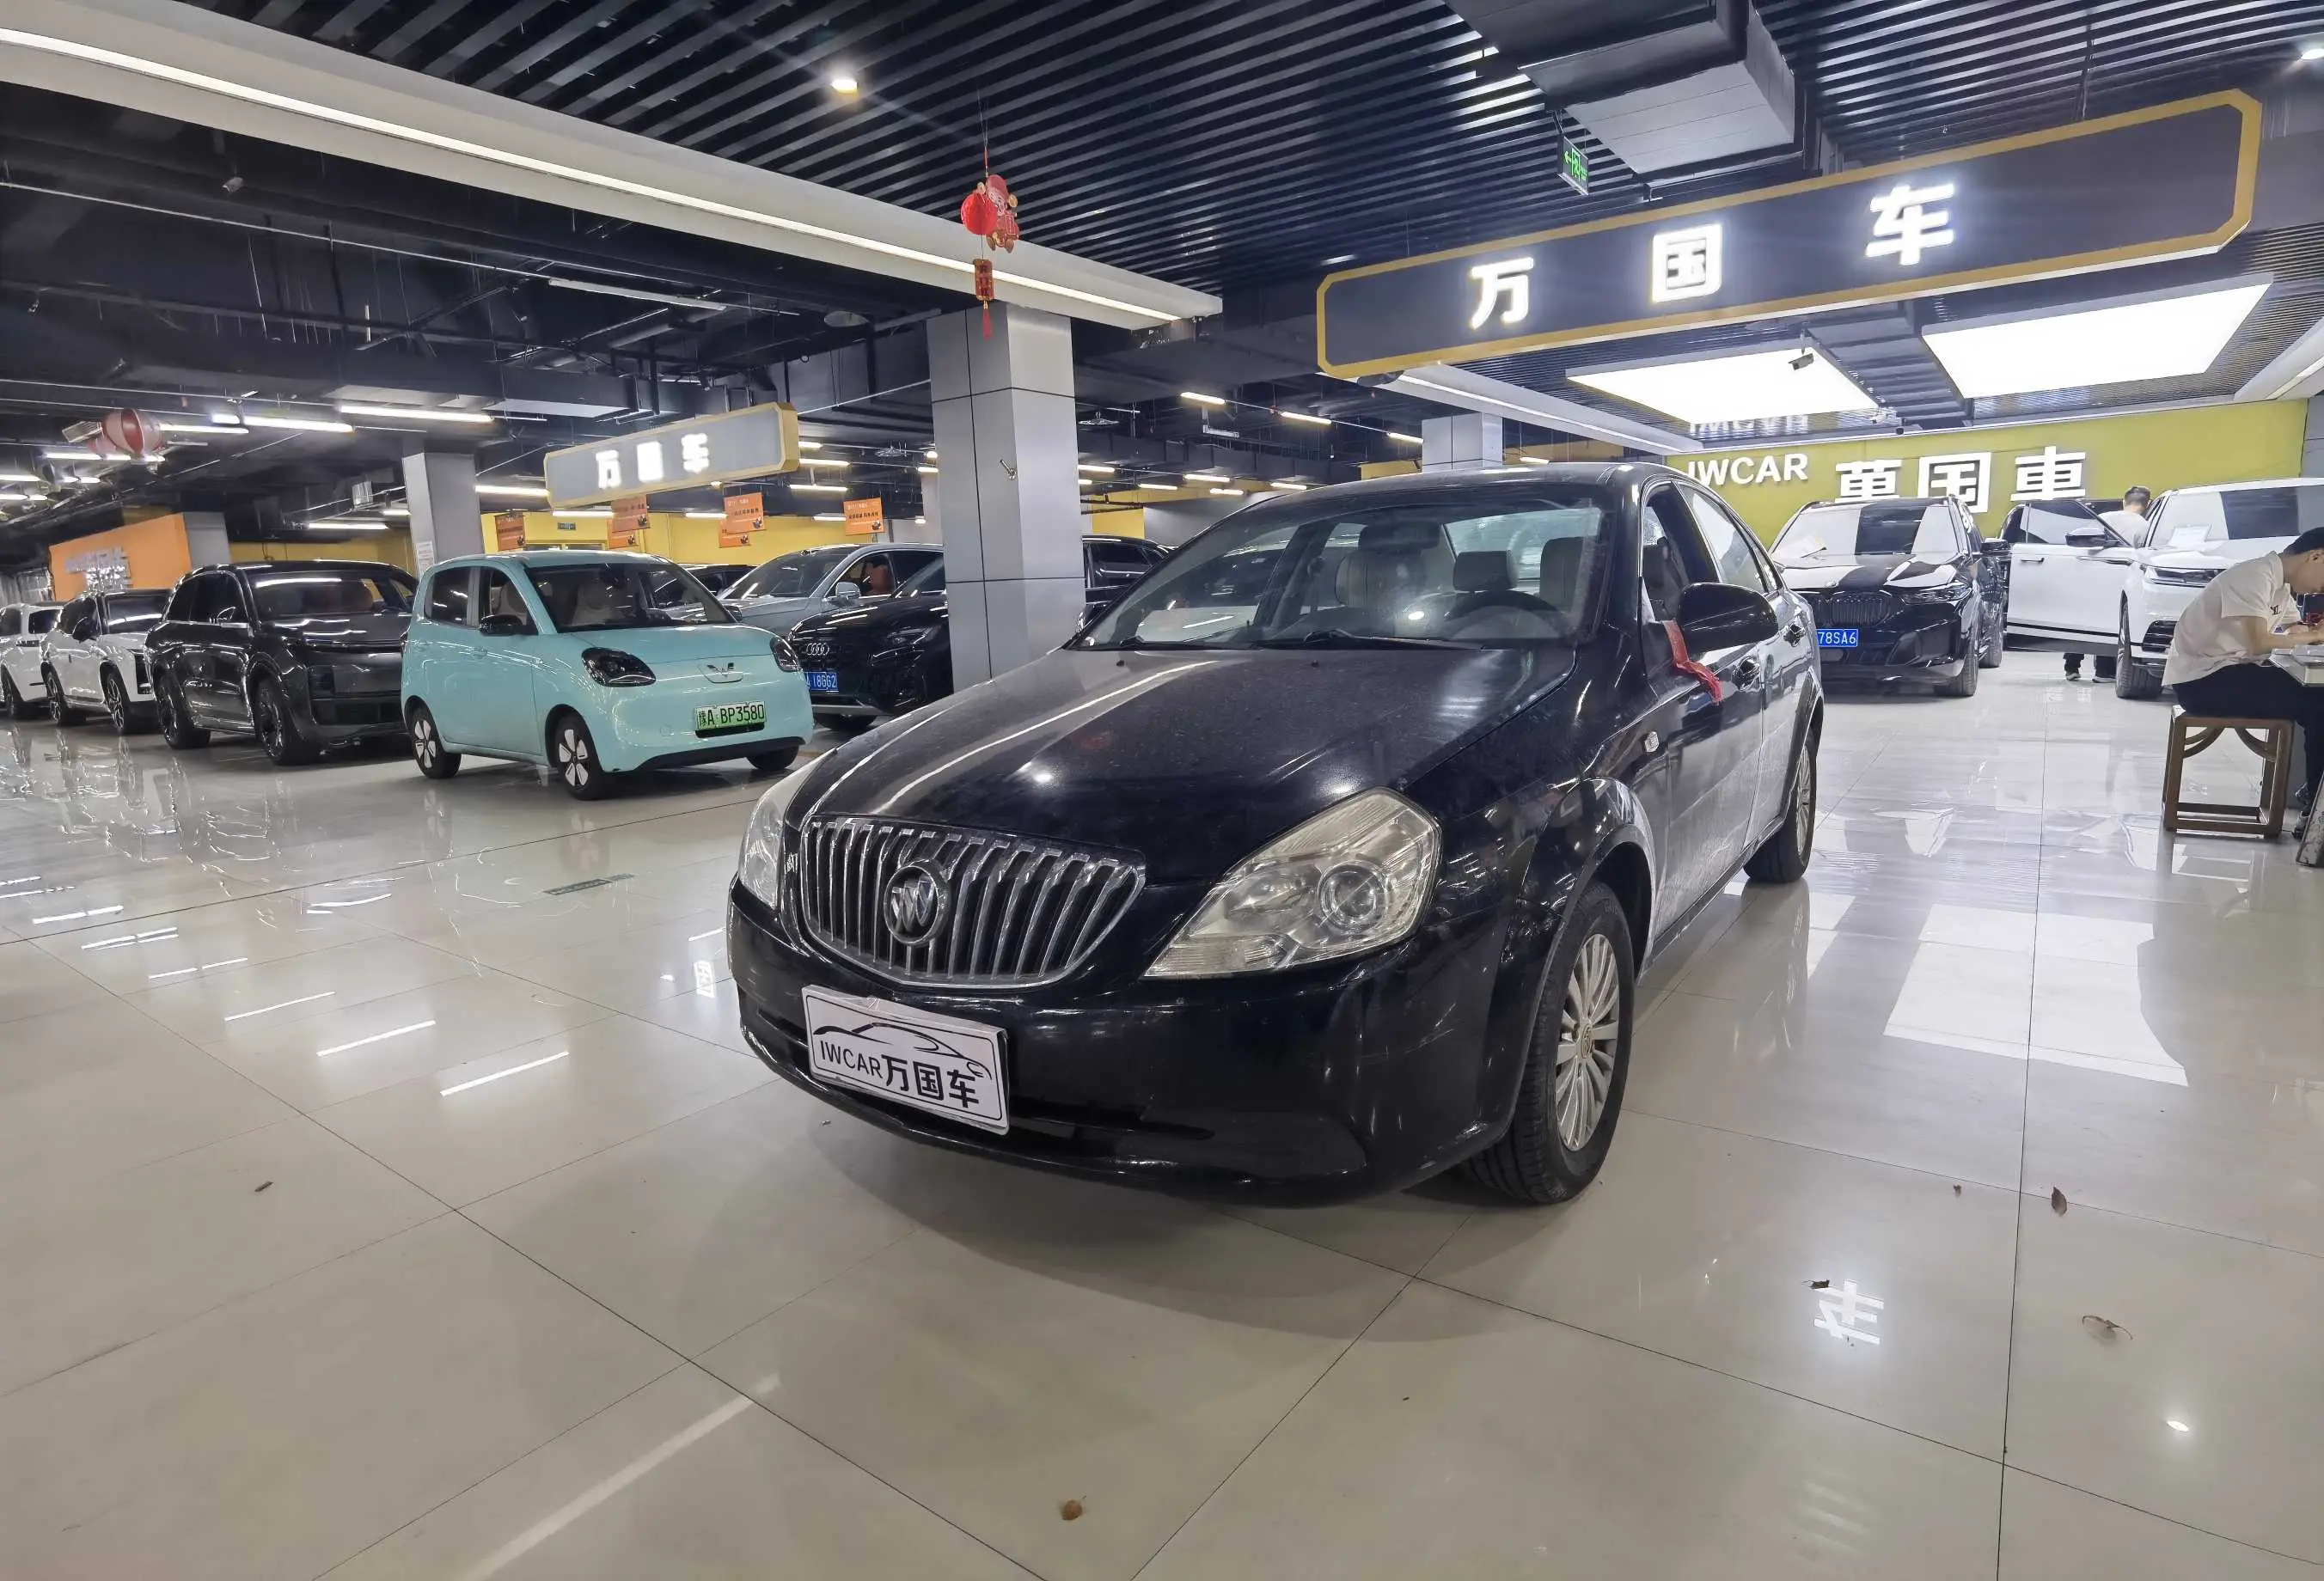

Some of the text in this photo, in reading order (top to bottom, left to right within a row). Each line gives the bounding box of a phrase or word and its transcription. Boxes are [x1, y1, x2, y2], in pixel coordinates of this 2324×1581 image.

[1470, 183, 1954, 329] 万国车
[596, 433, 709, 490] 万车
